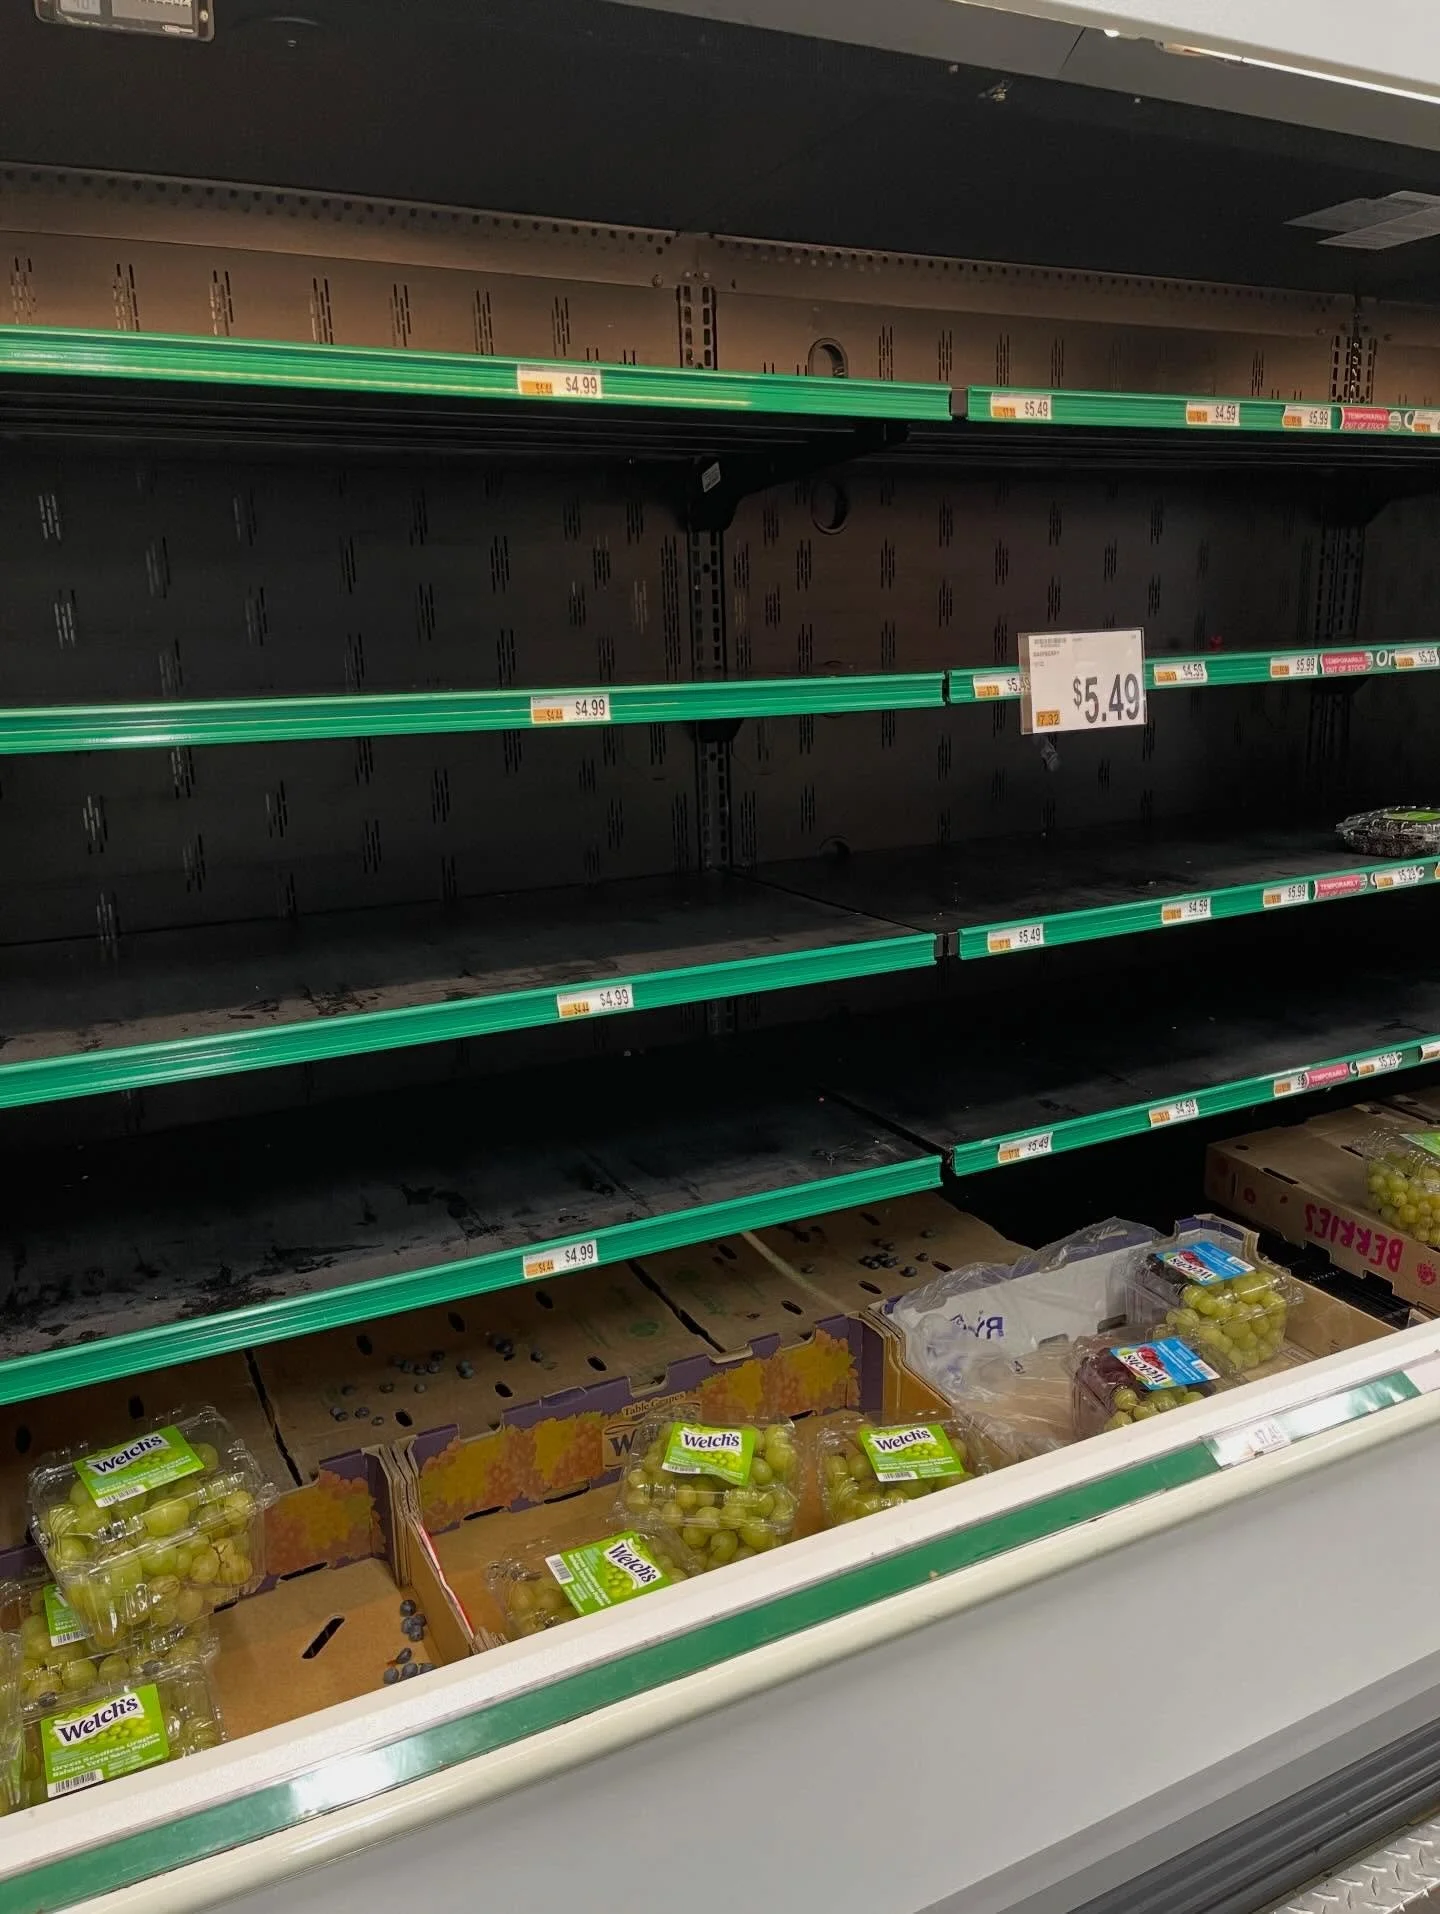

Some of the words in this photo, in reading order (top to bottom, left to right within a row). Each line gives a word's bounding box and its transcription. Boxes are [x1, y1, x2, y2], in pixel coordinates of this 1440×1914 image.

[565, 376, 598, 395] $4.99
[1025, 402, 1048, 417] $5.49
[1215, 406, 1236, 421] $4.59
[1309, 411, 1329, 426] $5.99
[1182, 664, 1204, 677] $4.59
[1296, 658, 1315, 672] $5.99
[1073, 673, 1140, 724] $5.49
[576, 698, 606, 718] $4.99
[1288, 885, 1306, 899] $5.99
[1189, 899, 1208, 913] $4.59
[1019, 928, 1041, 943] $5.49
[600, 988, 629, 1007] $4.99
[1175, 1100, 1195, 1114] $4.59
[1028, 1136, 1049, 1151] $5.49
[1305, 1203, 1404, 1272] BERRIES
[565, 1244, 594, 1263] $4.99
[1123, 1353, 1168, 1384] Welch's
[624, 1399, 650, 1416] Table
[683, 1432, 740, 1450] Welch's
[875, 1430, 930, 1451] Welch's
[94, 1435, 163, 1473] Welch's
[608, 1542, 657, 1584] Welch's
[58, 1696, 138, 1743] Welch's
